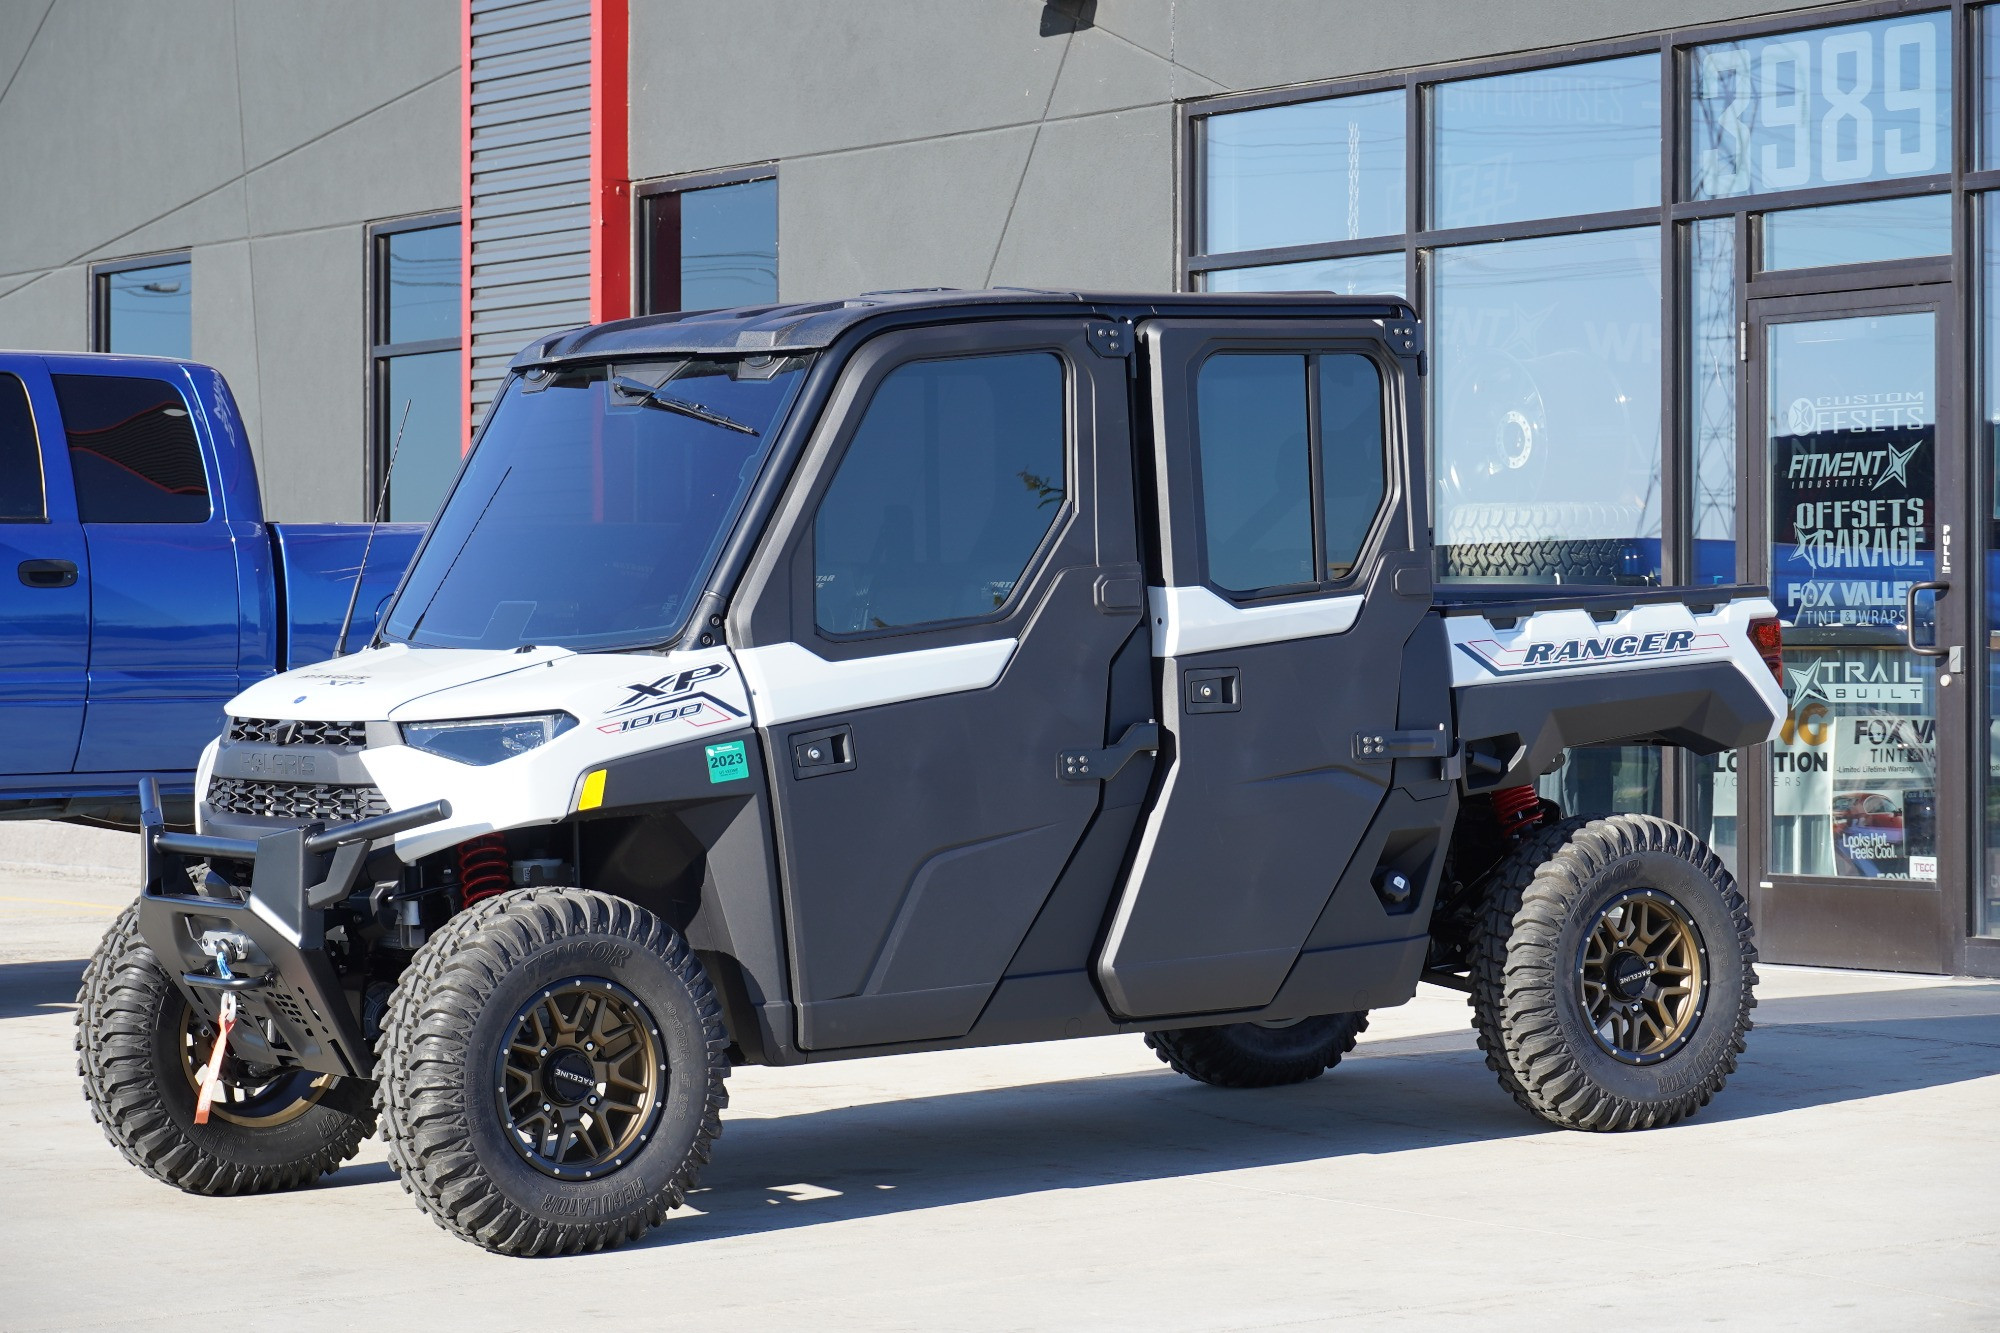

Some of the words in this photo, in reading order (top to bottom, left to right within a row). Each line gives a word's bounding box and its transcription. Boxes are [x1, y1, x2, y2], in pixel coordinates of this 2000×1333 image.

[1702, 21, 1936, 196] 3989
[1816, 391, 1924, 407] CUSTOM
[1788, 450, 1887, 479] FITMENT
[1791, 478, 1873, 490] INDUSTRIES
[1796, 497, 1924, 529] OFFSETS
[1816, 527, 1924, 568] GARAGE
[1788, 579, 1835, 607] FOX
[1805, 610, 1835, 625] TINT
[1858, 609, 1906, 625] WRAPS
[1522, 629, 1697, 666] RANGER
[1820, 661, 1923, 683] TRAIL
[612, 662, 731, 712] XP
[1836, 688, 1921, 699] BUILT
[619, 701, 704, 733] 1000
[1854, 719, 1907, 745] FOX
[240, 752, 316, 777] POLARIS
[710, 753, 744, 769] 2023
[1870, 748, 1904, 763] TINT
[1862, 765, 1887, 774] Lifetime
[1888, 765, 1915, 774] Warranty
[1842, 833, 1871, 848] Looks
[1871, 833, 1889, 847] Hot.
[1850, 846, 1875, 860] Feels
[1875, 845, 1898, 859] Cool.
[523, 940, 633, 975] TENSOR
[1619, 968, 1653, 986] RACELINE
[554, 1067, 597, 1087] RACELINE
[541, 1174, 648, 1219] REGULATOR
